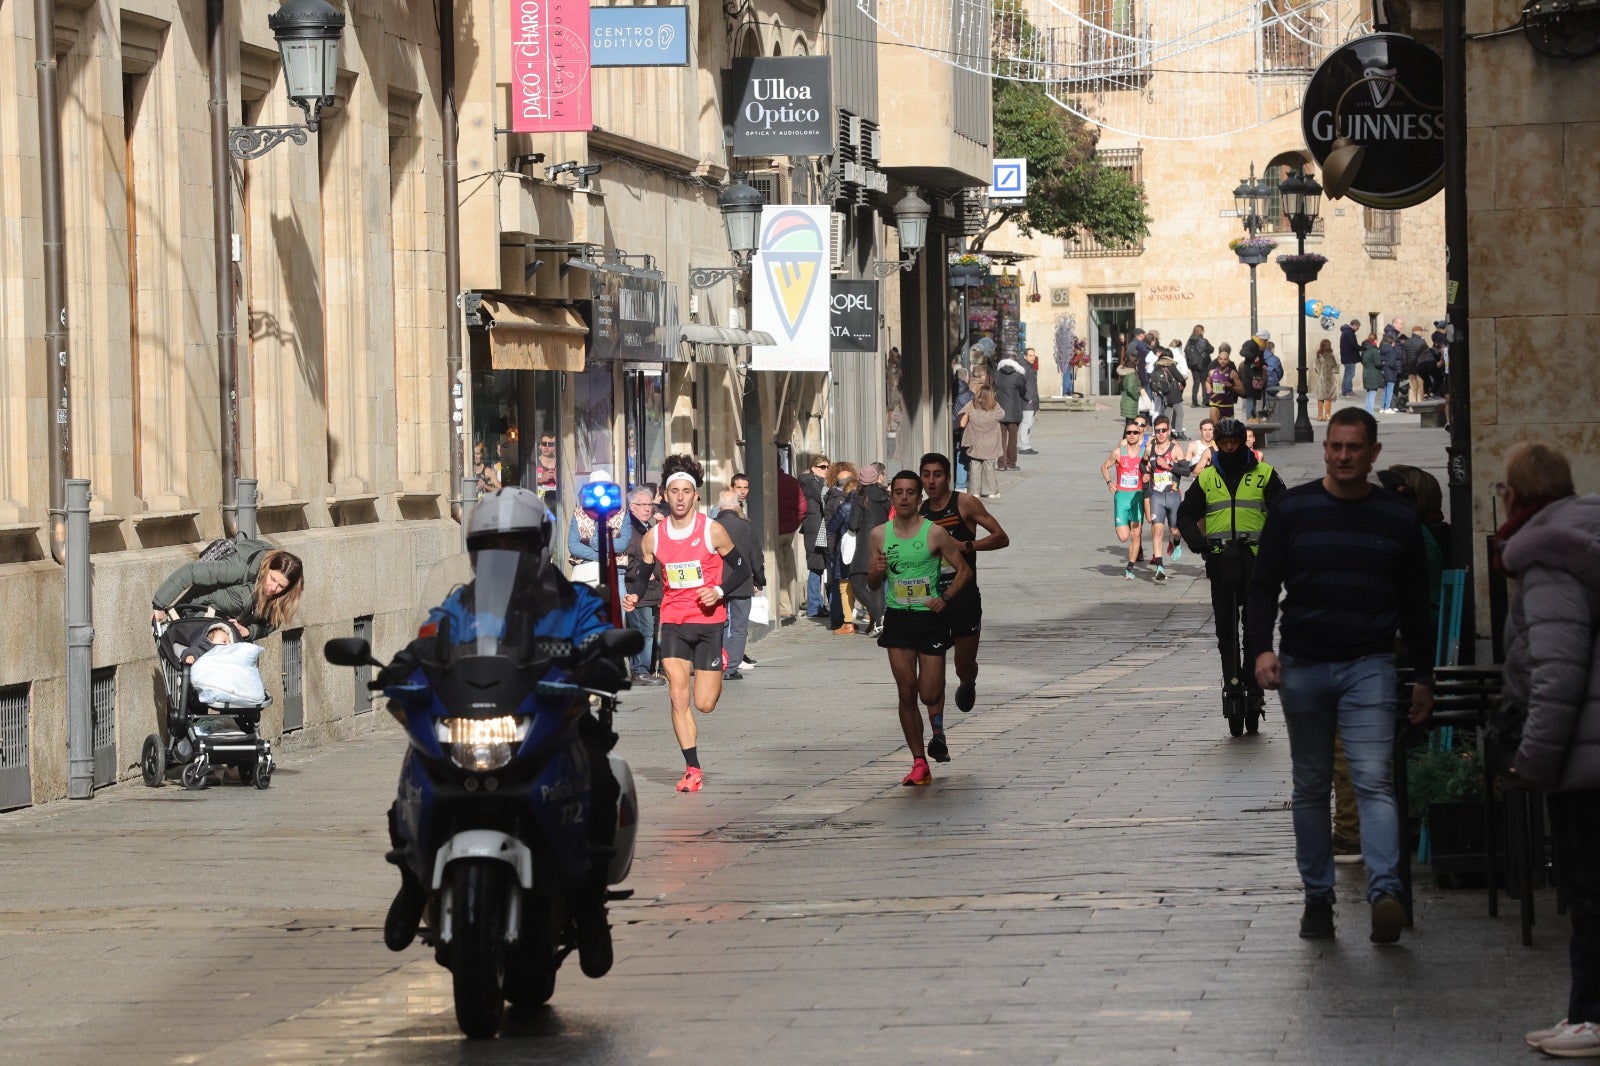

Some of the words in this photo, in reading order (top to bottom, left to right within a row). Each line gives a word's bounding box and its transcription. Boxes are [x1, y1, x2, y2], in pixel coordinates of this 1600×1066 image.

[513, 1, 540, 57] CHARO
[595, 27, 654, 37] CENTRO
[593, 38, 654, 48] UDITIVO
[522, 73, 548, 119] PACO
[751, 78, 813, 101] Ulloa
[745, 101, 820, 130] Optico
[1311, 110, 1446, 141] GUINNESS
[678, 569, 685, 580] 3
[907, 585, 914, 596] 5
